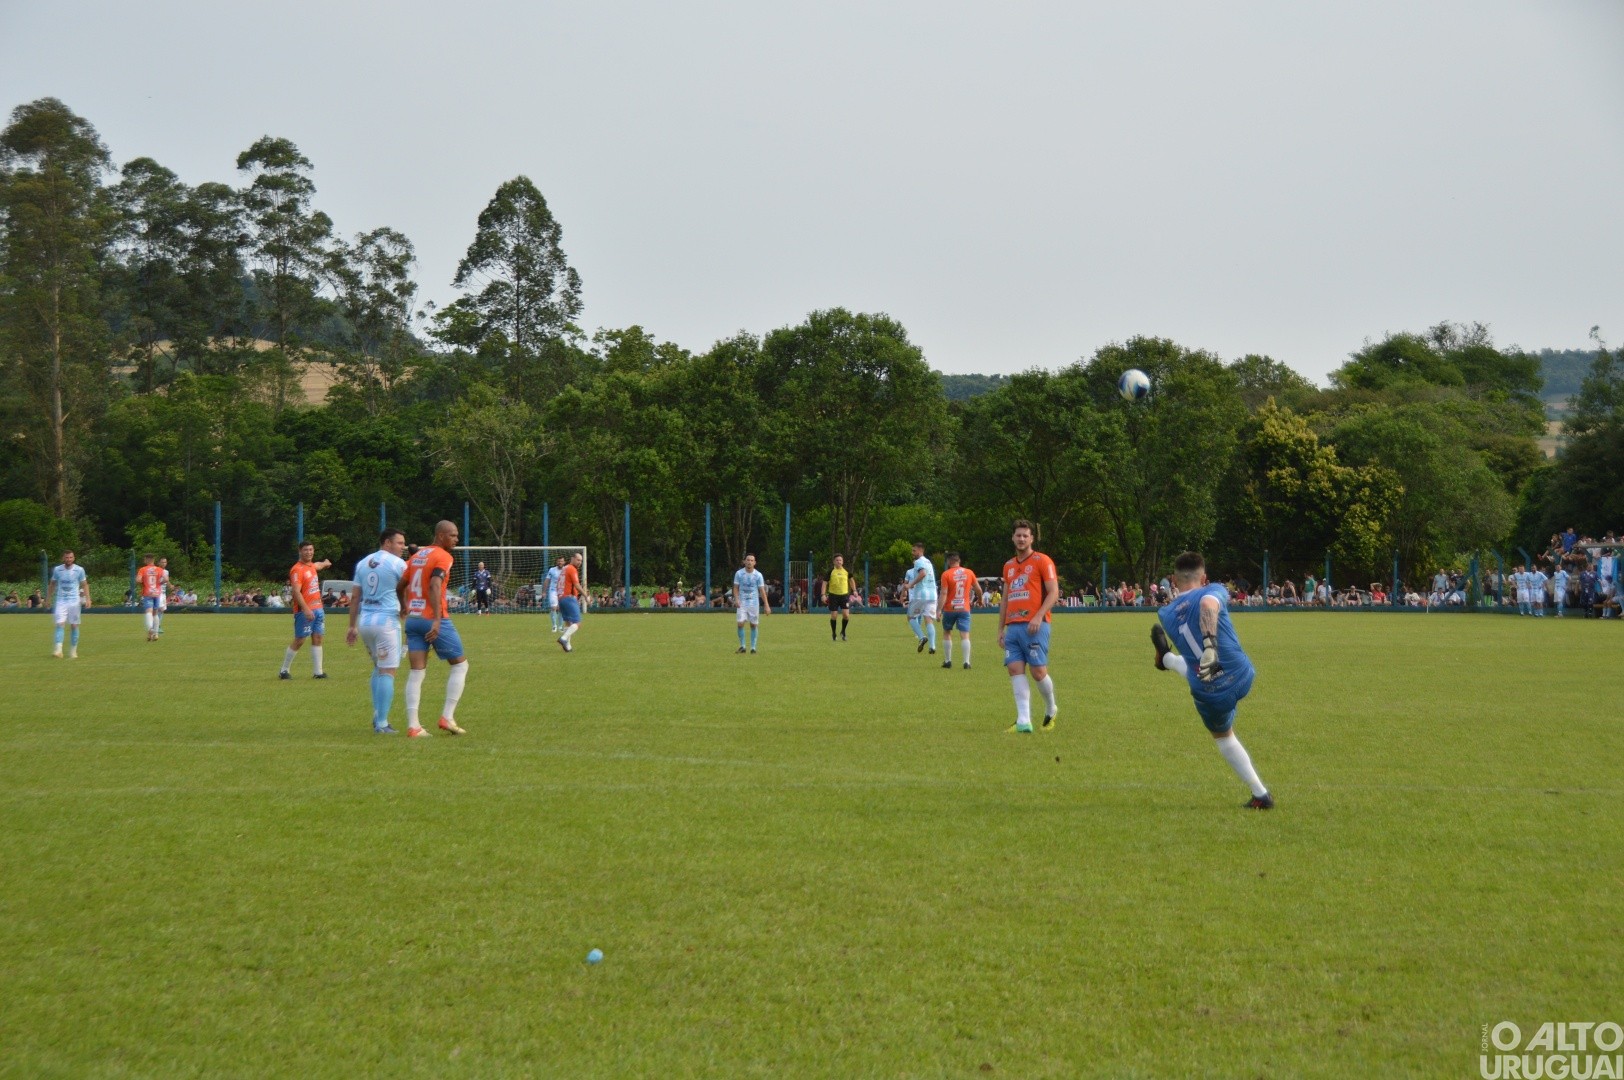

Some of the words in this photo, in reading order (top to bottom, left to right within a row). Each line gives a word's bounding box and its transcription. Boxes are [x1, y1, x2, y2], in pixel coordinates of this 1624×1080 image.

[367, 571, 379, 597] 9
[411, 568, 423, 598] 4
[955, 581, 965, 598] 6
[1178, 621, 1203, 660] 1
